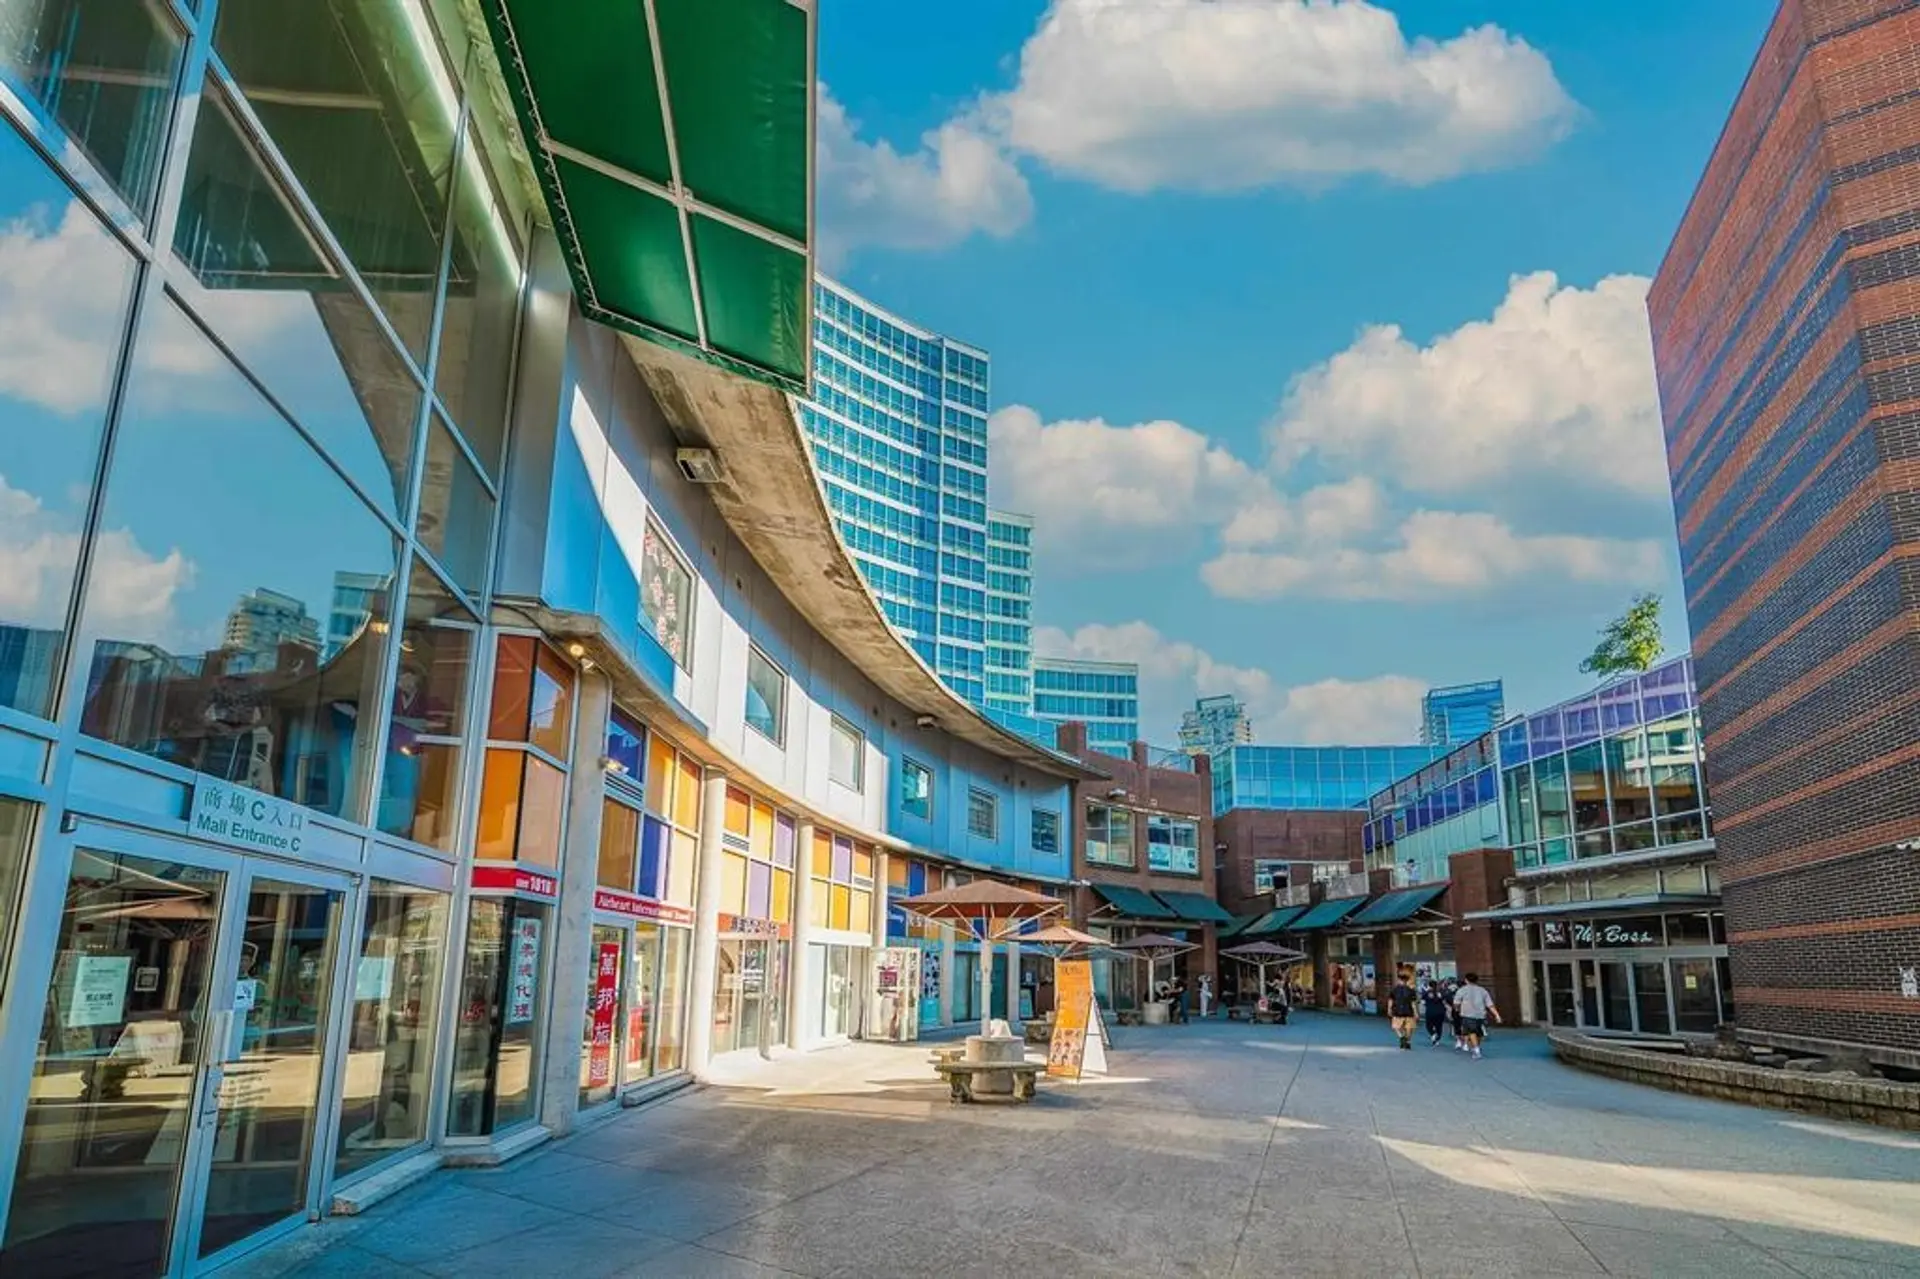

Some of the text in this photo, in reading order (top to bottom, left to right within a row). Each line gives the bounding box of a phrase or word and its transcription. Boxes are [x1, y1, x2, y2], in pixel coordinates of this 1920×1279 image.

[197, 813, 301, 852] Mall Entrance C
[1604, 924, 1653, 943] Boss
